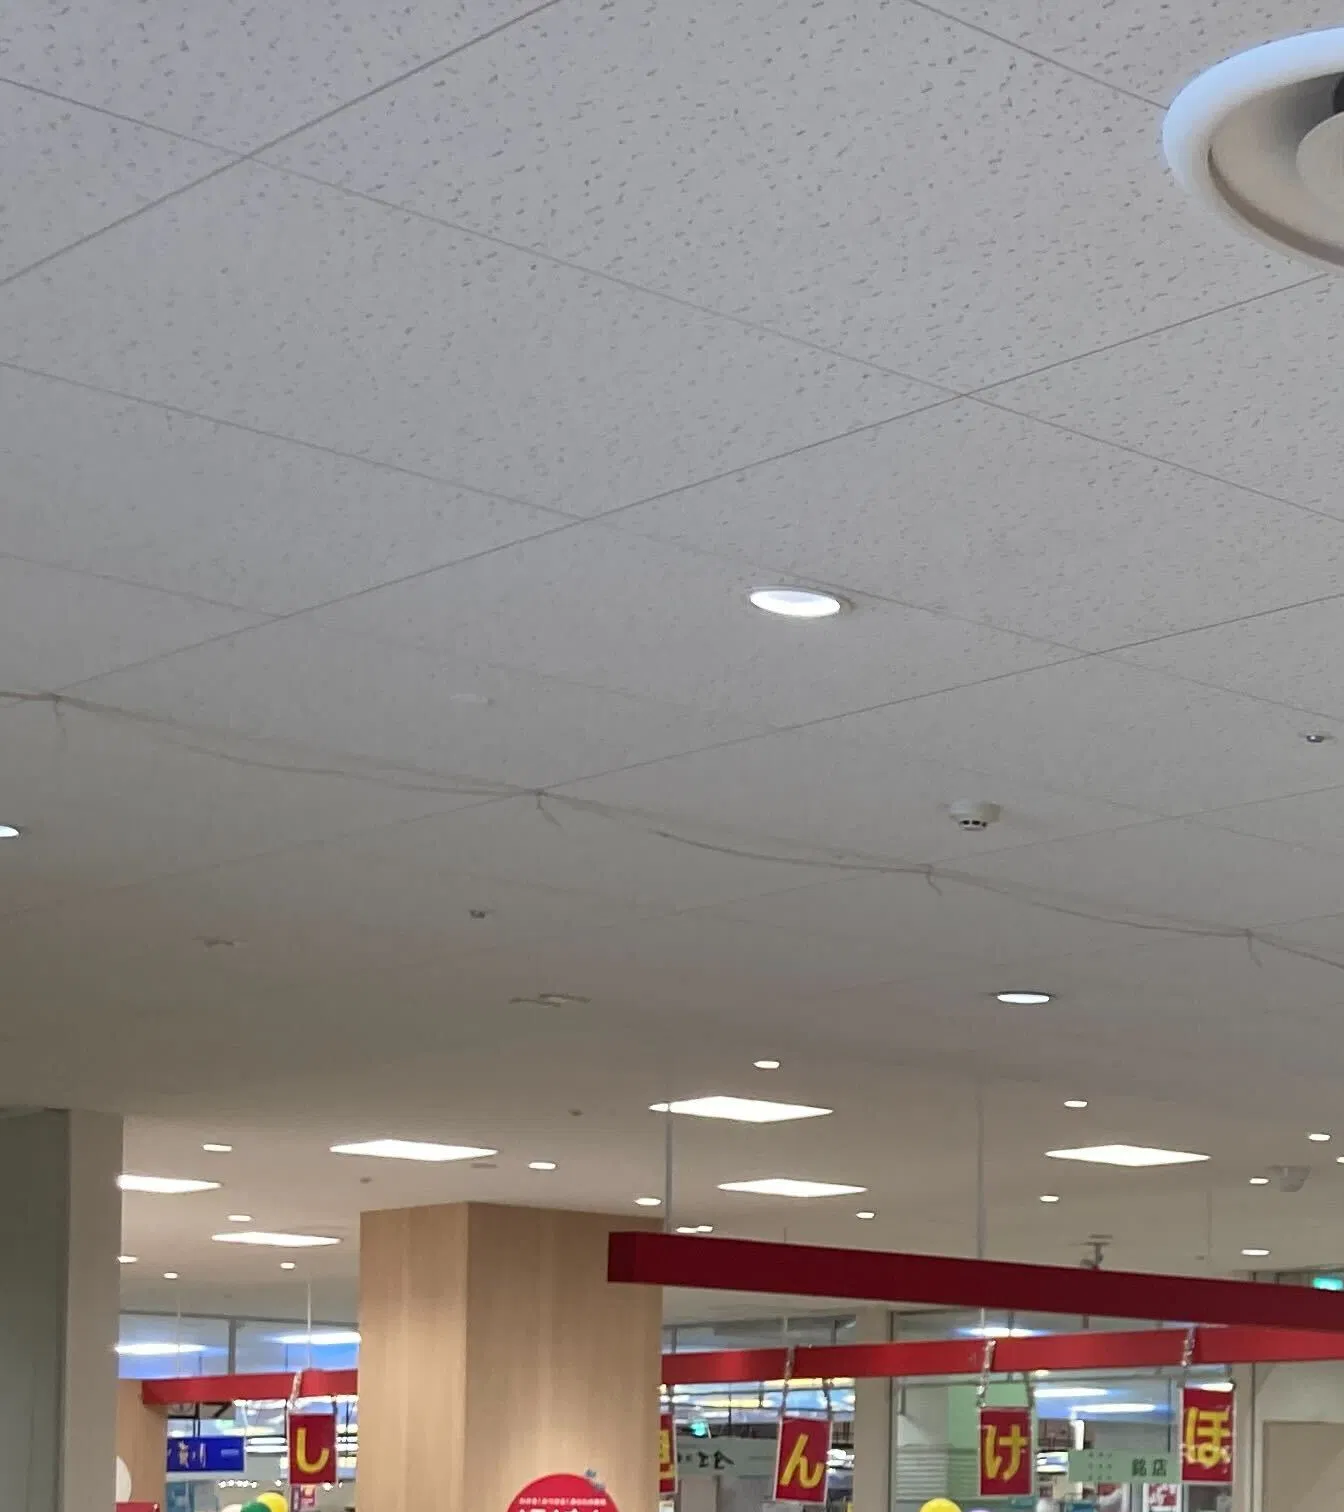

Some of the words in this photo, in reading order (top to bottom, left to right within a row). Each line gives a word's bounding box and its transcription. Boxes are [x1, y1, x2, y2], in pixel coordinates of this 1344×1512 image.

[296, 1426, 330, 1474] し
[779, 1433, 826, 1490] ん
[984, 1423, 1028, 1481] け
